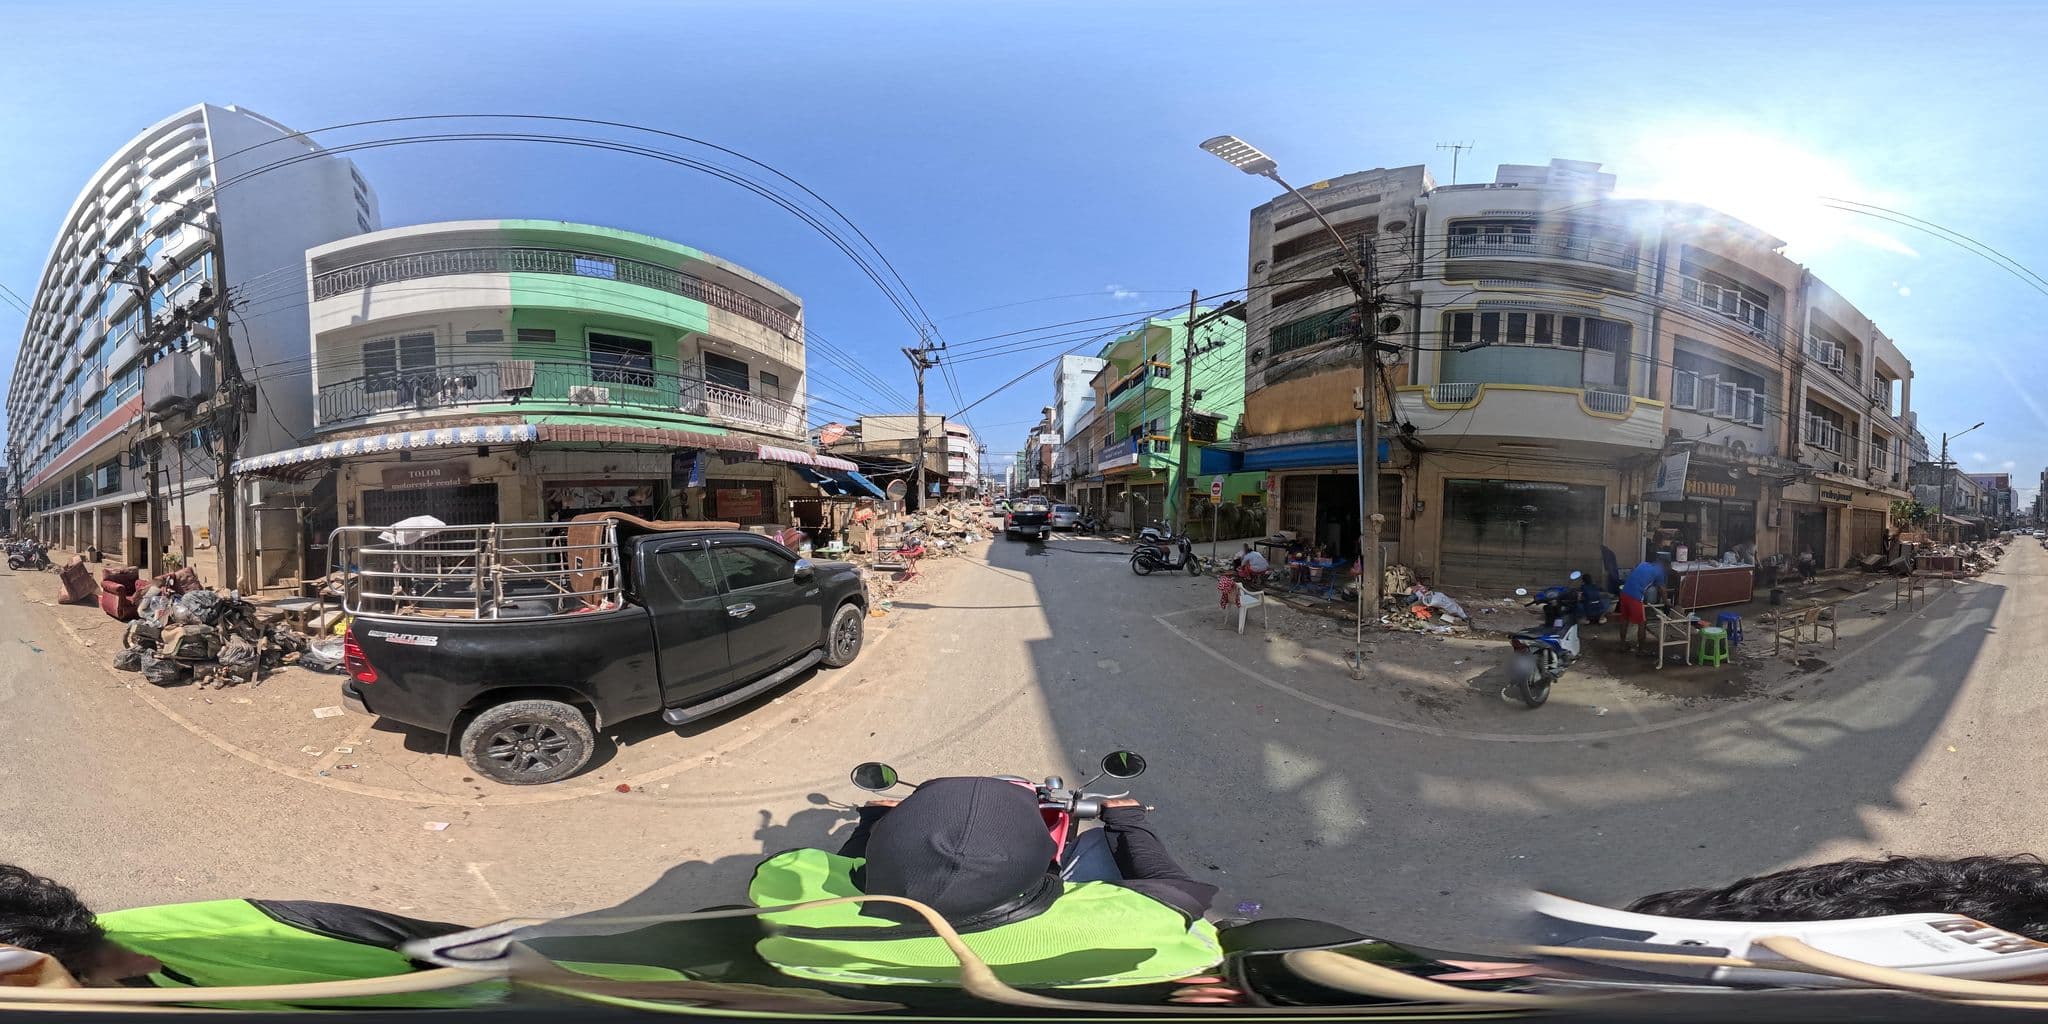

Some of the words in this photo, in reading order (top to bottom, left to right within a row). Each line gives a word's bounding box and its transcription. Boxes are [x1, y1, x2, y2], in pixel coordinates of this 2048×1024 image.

[408, 469, 441, 479] TOLOM
[391, 480, 433, 490] motorcycle
[436, 477, 461, 487] rental
